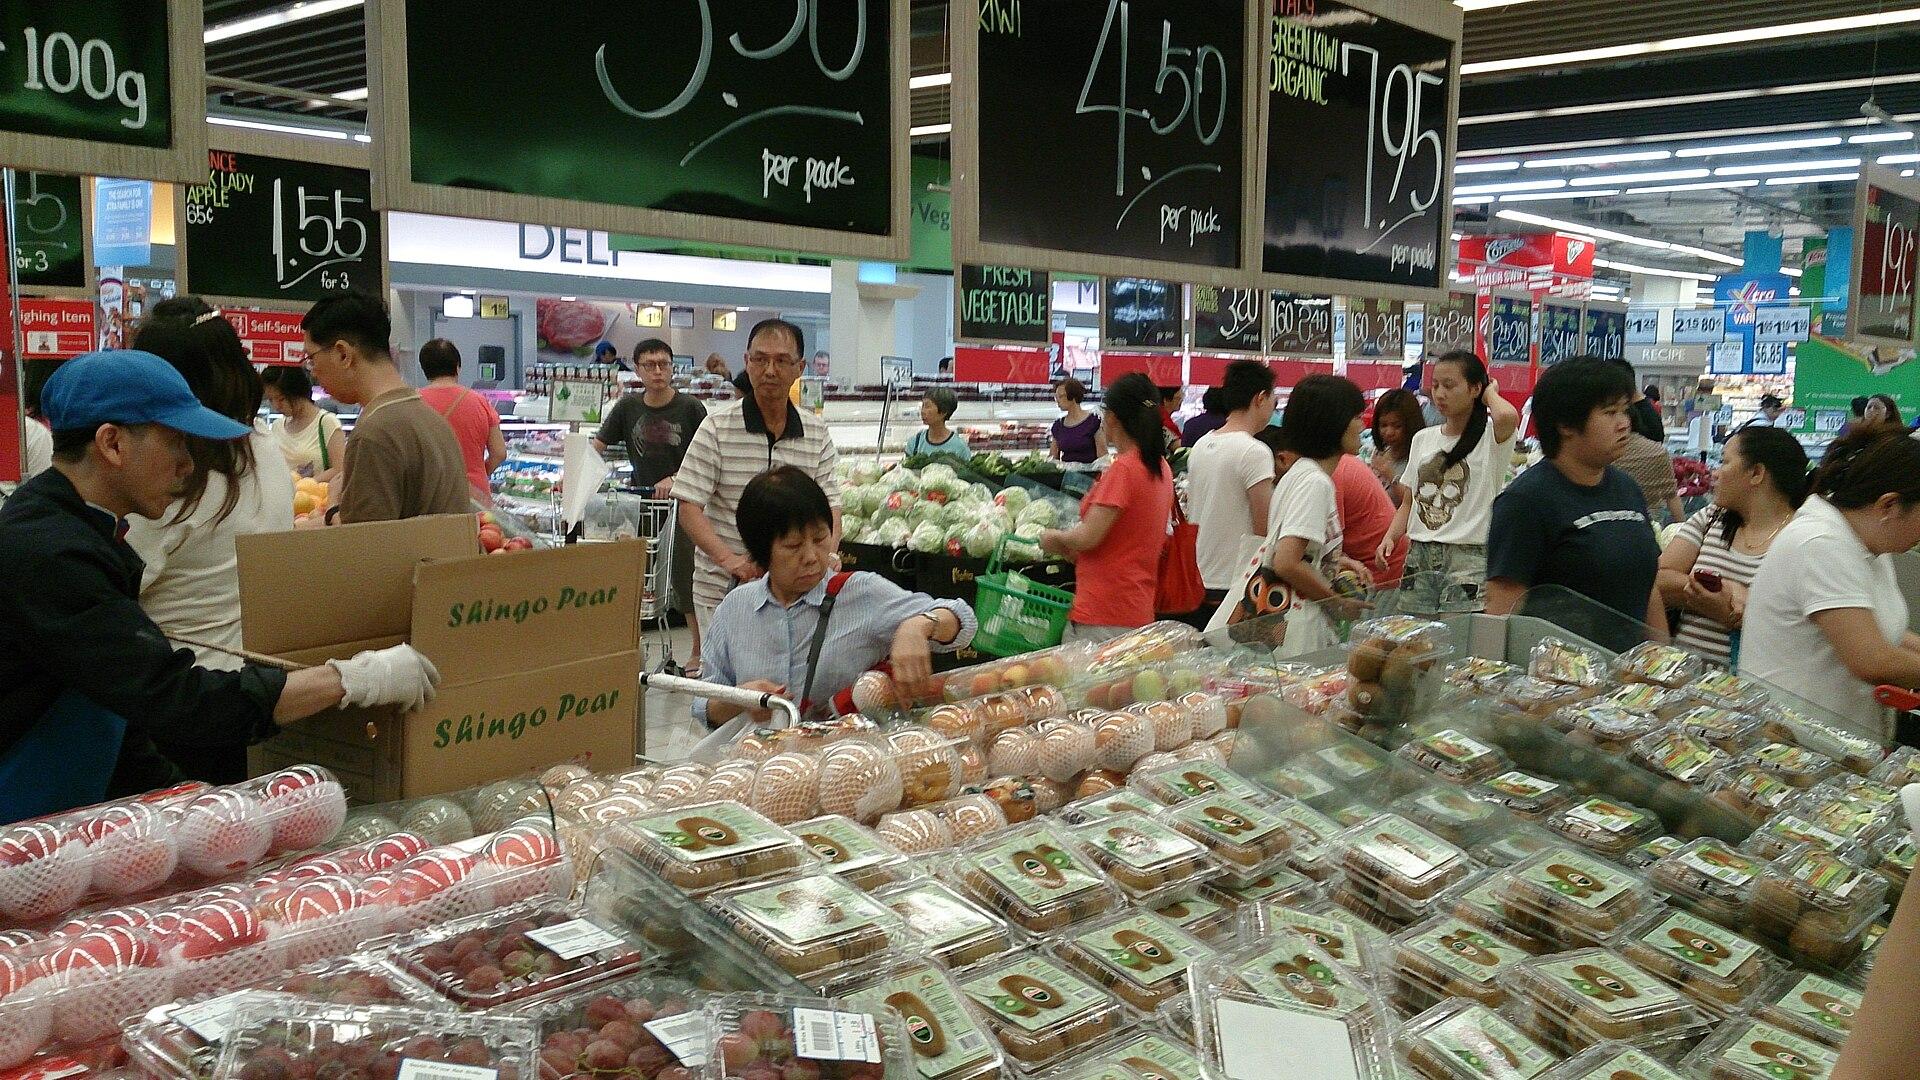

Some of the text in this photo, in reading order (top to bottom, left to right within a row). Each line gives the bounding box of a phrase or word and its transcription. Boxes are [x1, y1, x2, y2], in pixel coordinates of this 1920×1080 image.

[1271, 16, 1339, 72] GREEN KIWI
[24, 27, 147, 129] 100g
[1076, 0, 1227, 196] 4.50
[1269, 55, 1328, 106] ORGANIC
[1341, 42, 1444, 229] 7.95
[220, 171, 254, 195] LADY
[762, 148, 855, 203] per pack
[186, 185, 230, 208] APPLE
[272, 177, 367, 282] 1.55
[1160, 204, 1221, 248] per pack
[35, 250, 49, 272] 3
[320, 270, 350, 290] for 3
[983, 265, 1031, 288] FRESH
[1390, 243, 1434, 277] per pack
[62, 309, 91, 323] Item
[960, 288, 1046, 326] VEGETABLE
[1642, 349, 1686, 362] RECIPE
[448, 586, 618, 627] Shingo Pear
[433, 689, 619, 748] Shingo Pear
